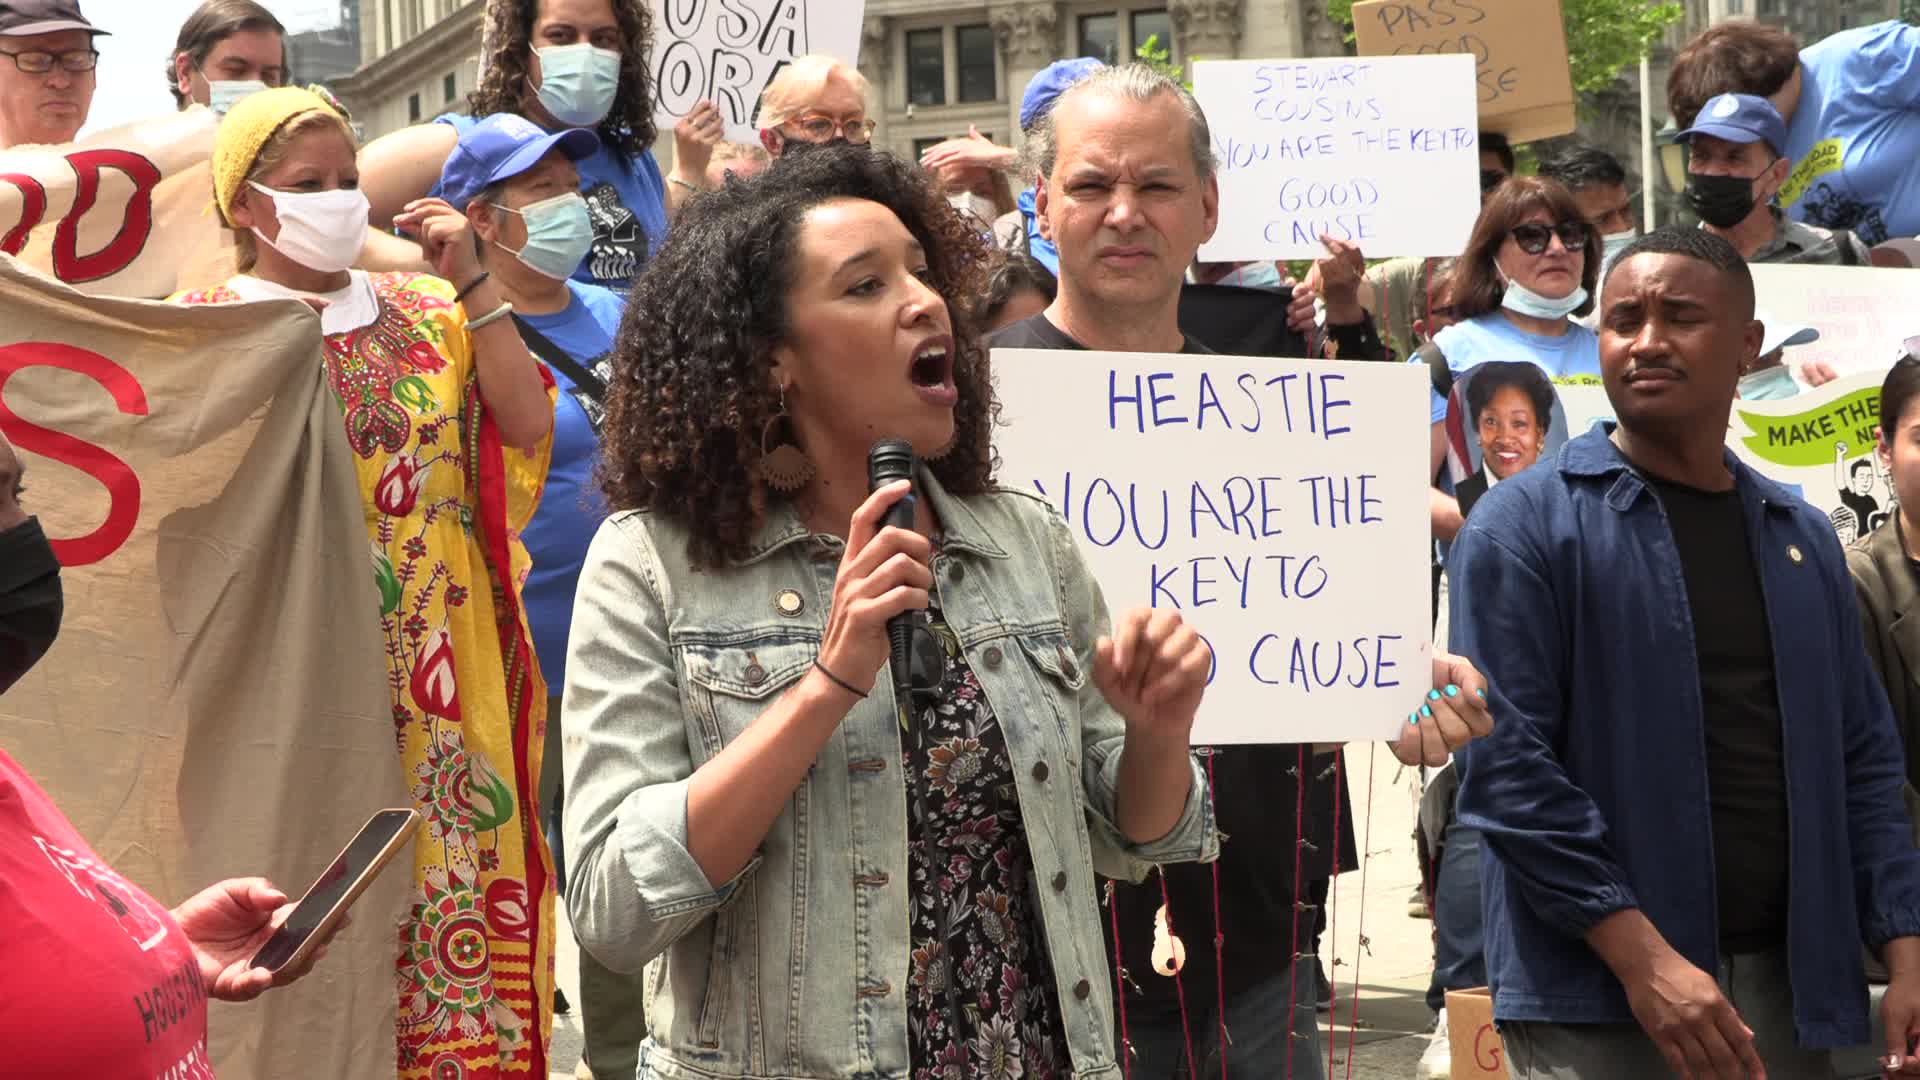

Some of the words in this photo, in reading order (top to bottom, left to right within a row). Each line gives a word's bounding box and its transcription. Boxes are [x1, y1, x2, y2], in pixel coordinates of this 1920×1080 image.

[1377, 0, 1486, 35] PASS
[1253, 63, 1372, 94] STEWART
[1254, 97, 1383, 122] COUSINS
[1213, 128, 1270, 170] YOU
[1280, 134, 1336, 160] ARE
[1351, 128, 1401, 151] THE
[1280, 177, 1378, 212] GOOD
[1264, 213, 1376, 245] CAUSE
[1108, 369, 1352, 439] HEASTIE
[1768, 414, 1836, 447] MAKE
[1833, 396, 1881, 428] THE
[1190, 475, 1283, 541] ARE
[1298, 474, 1384, 528] THE
[1150, 555, 1252, 609] KEY
[1265, 554, 1329, 600] TO
[1249, 633, 1403, 693] CAUSE
